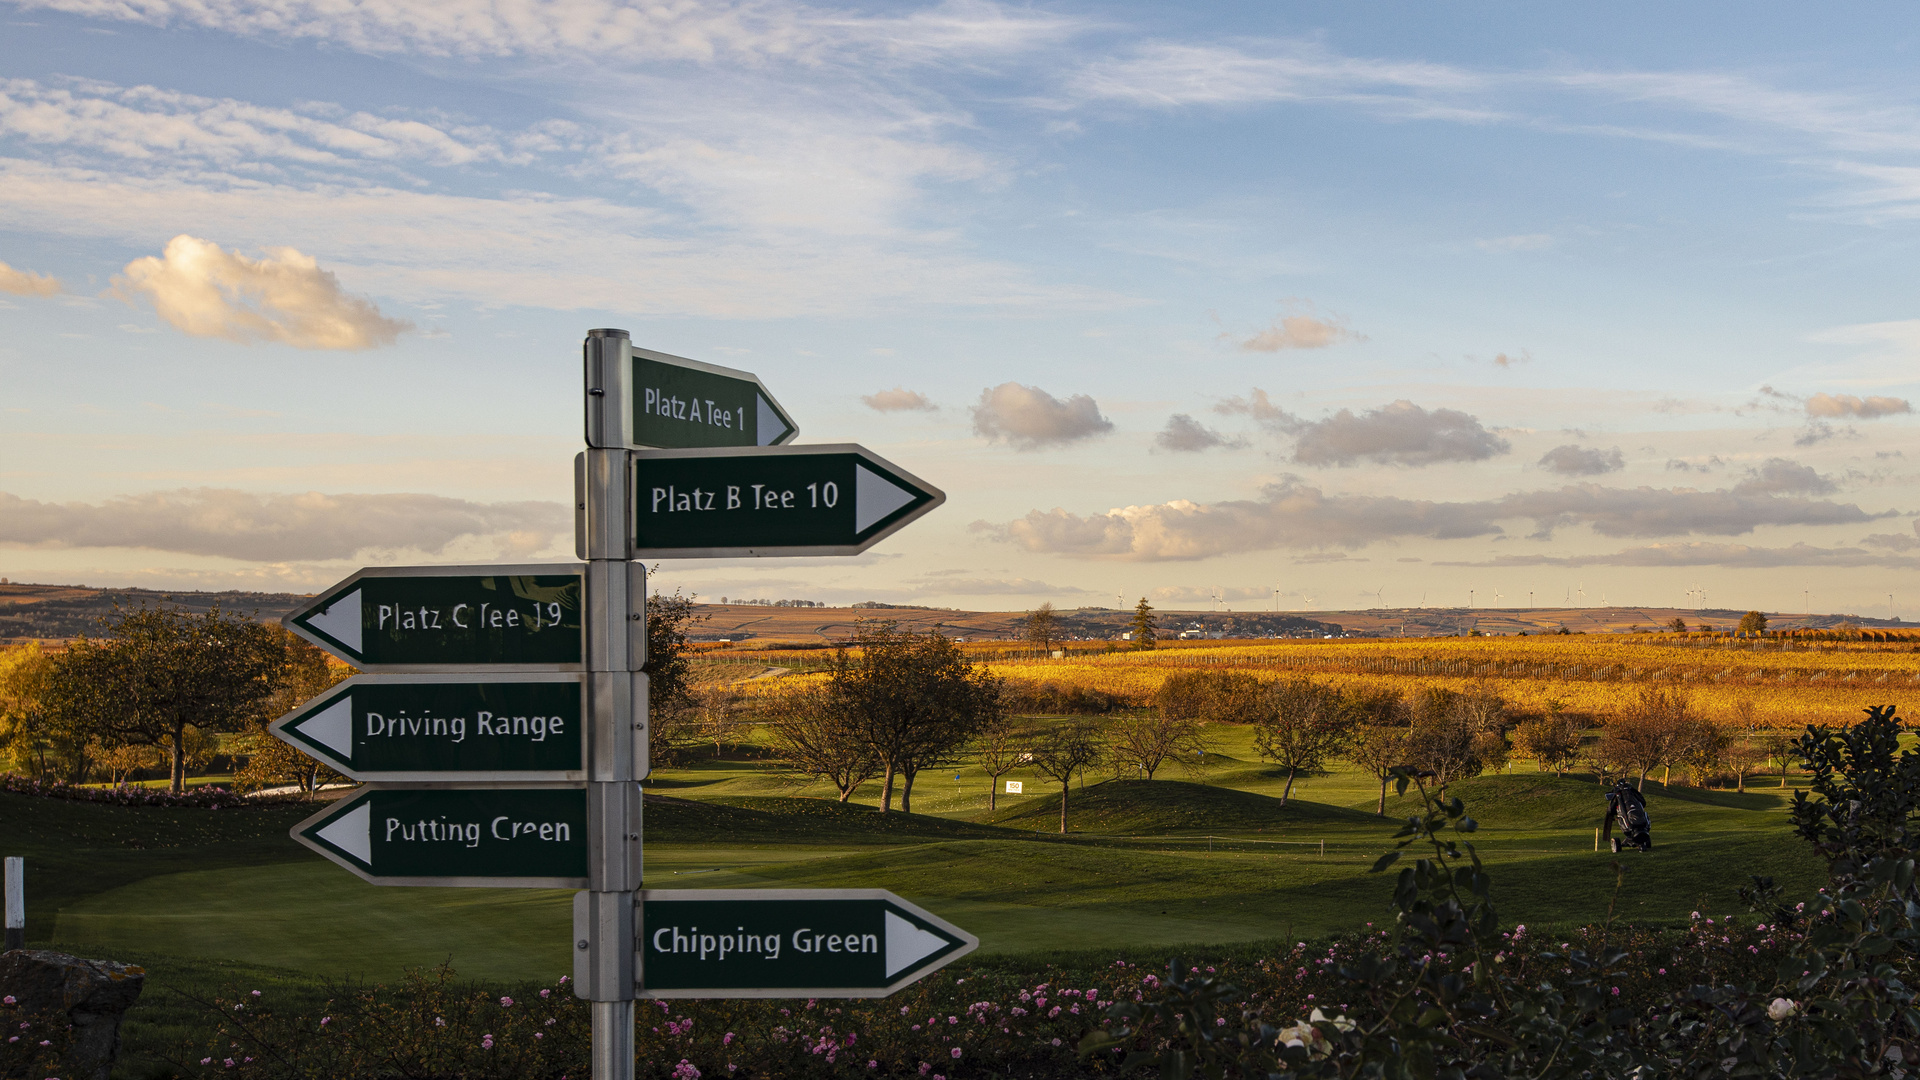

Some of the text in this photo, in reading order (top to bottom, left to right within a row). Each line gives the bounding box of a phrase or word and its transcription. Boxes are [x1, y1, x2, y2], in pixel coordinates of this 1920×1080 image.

[645, 388, 744, 431] Platz A Tee 1
[652, 481, 838, 513] Platz B Tee 10
[379, 602, 442, 630] Platz
[452, 603, 468, 629] C
[533, 602, 562, 628] 19
[367, 710, 564, 743] Driving Range
[386, 817, 480, 848] Putting
[653, 926, 878, 961] Chipping Green
